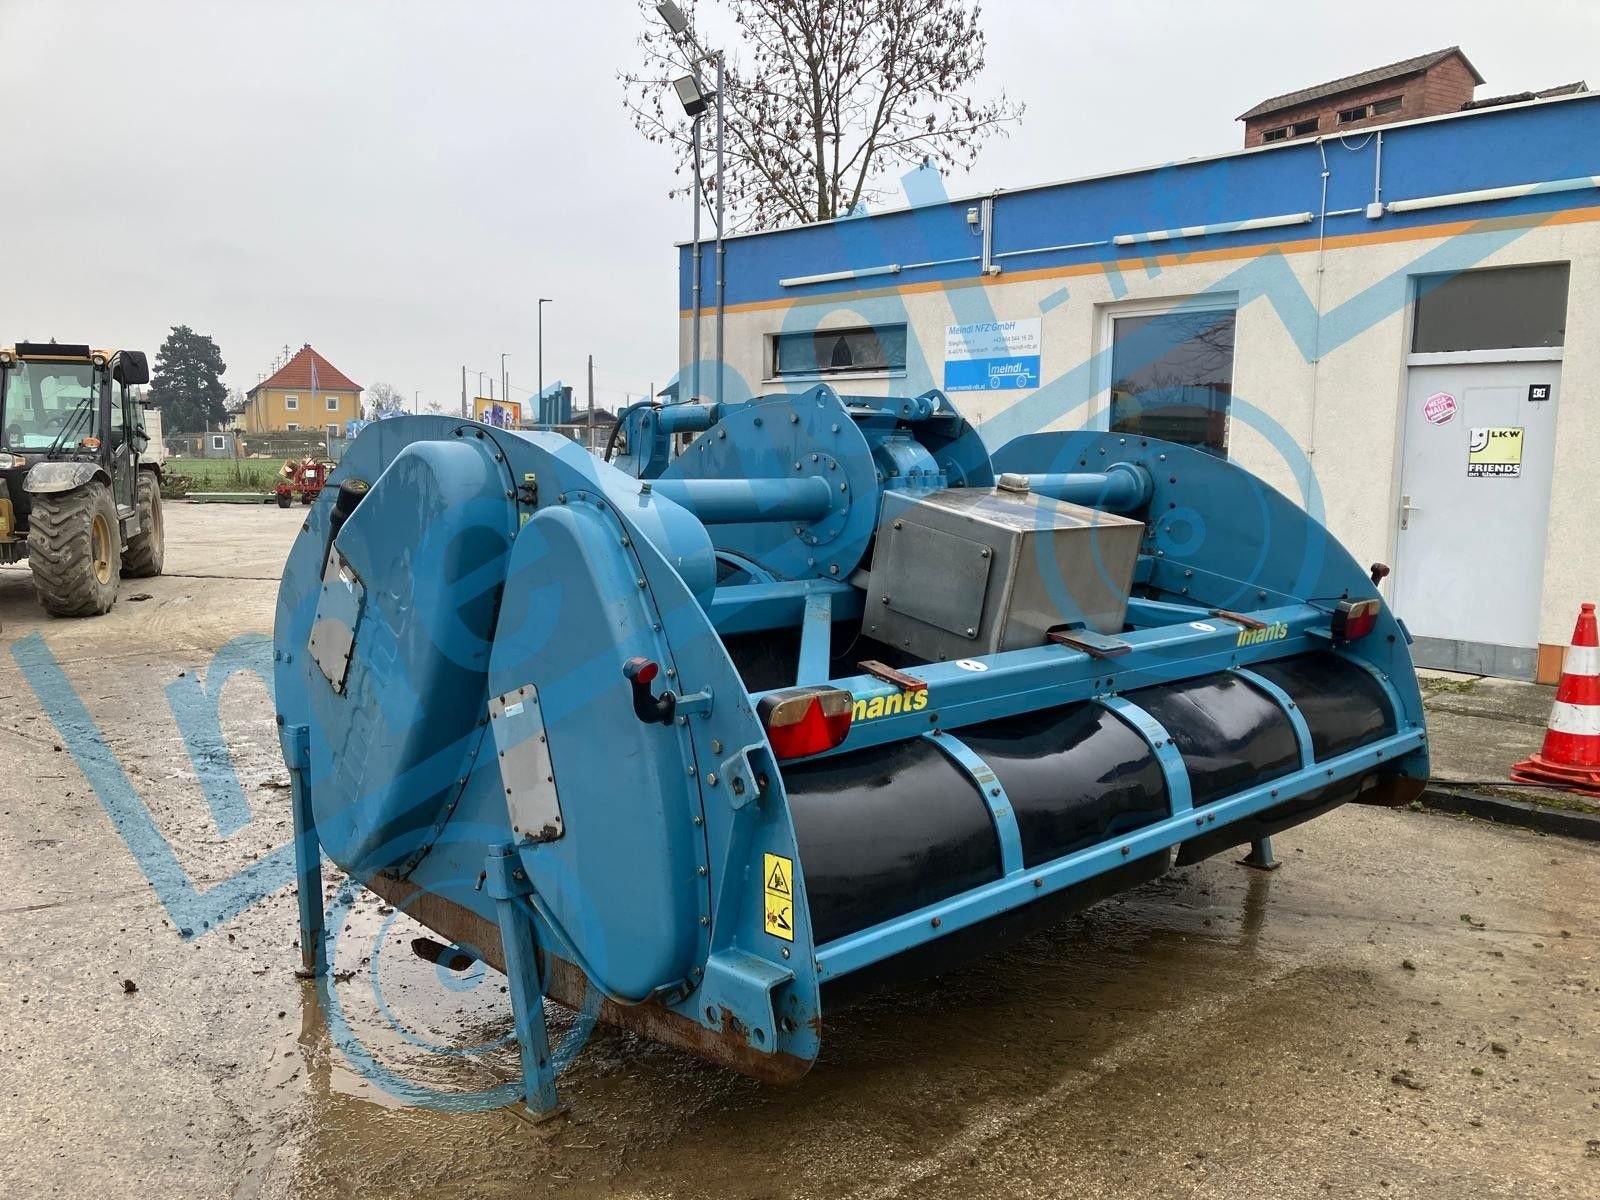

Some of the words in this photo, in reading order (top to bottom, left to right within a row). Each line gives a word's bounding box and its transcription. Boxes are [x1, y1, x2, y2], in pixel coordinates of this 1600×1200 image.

[949, 325, 974, 335] Meindl
[991, 321, 1016, 332] GmbH
[990, 362, 1023, 374] meindl
[1491, 430, 1521, 438] LKW
[1469, 464, 1520, 473] FRIENDS
[1236, 620, 1289, 648] Imants
[851, 688, 929, 722] mants
